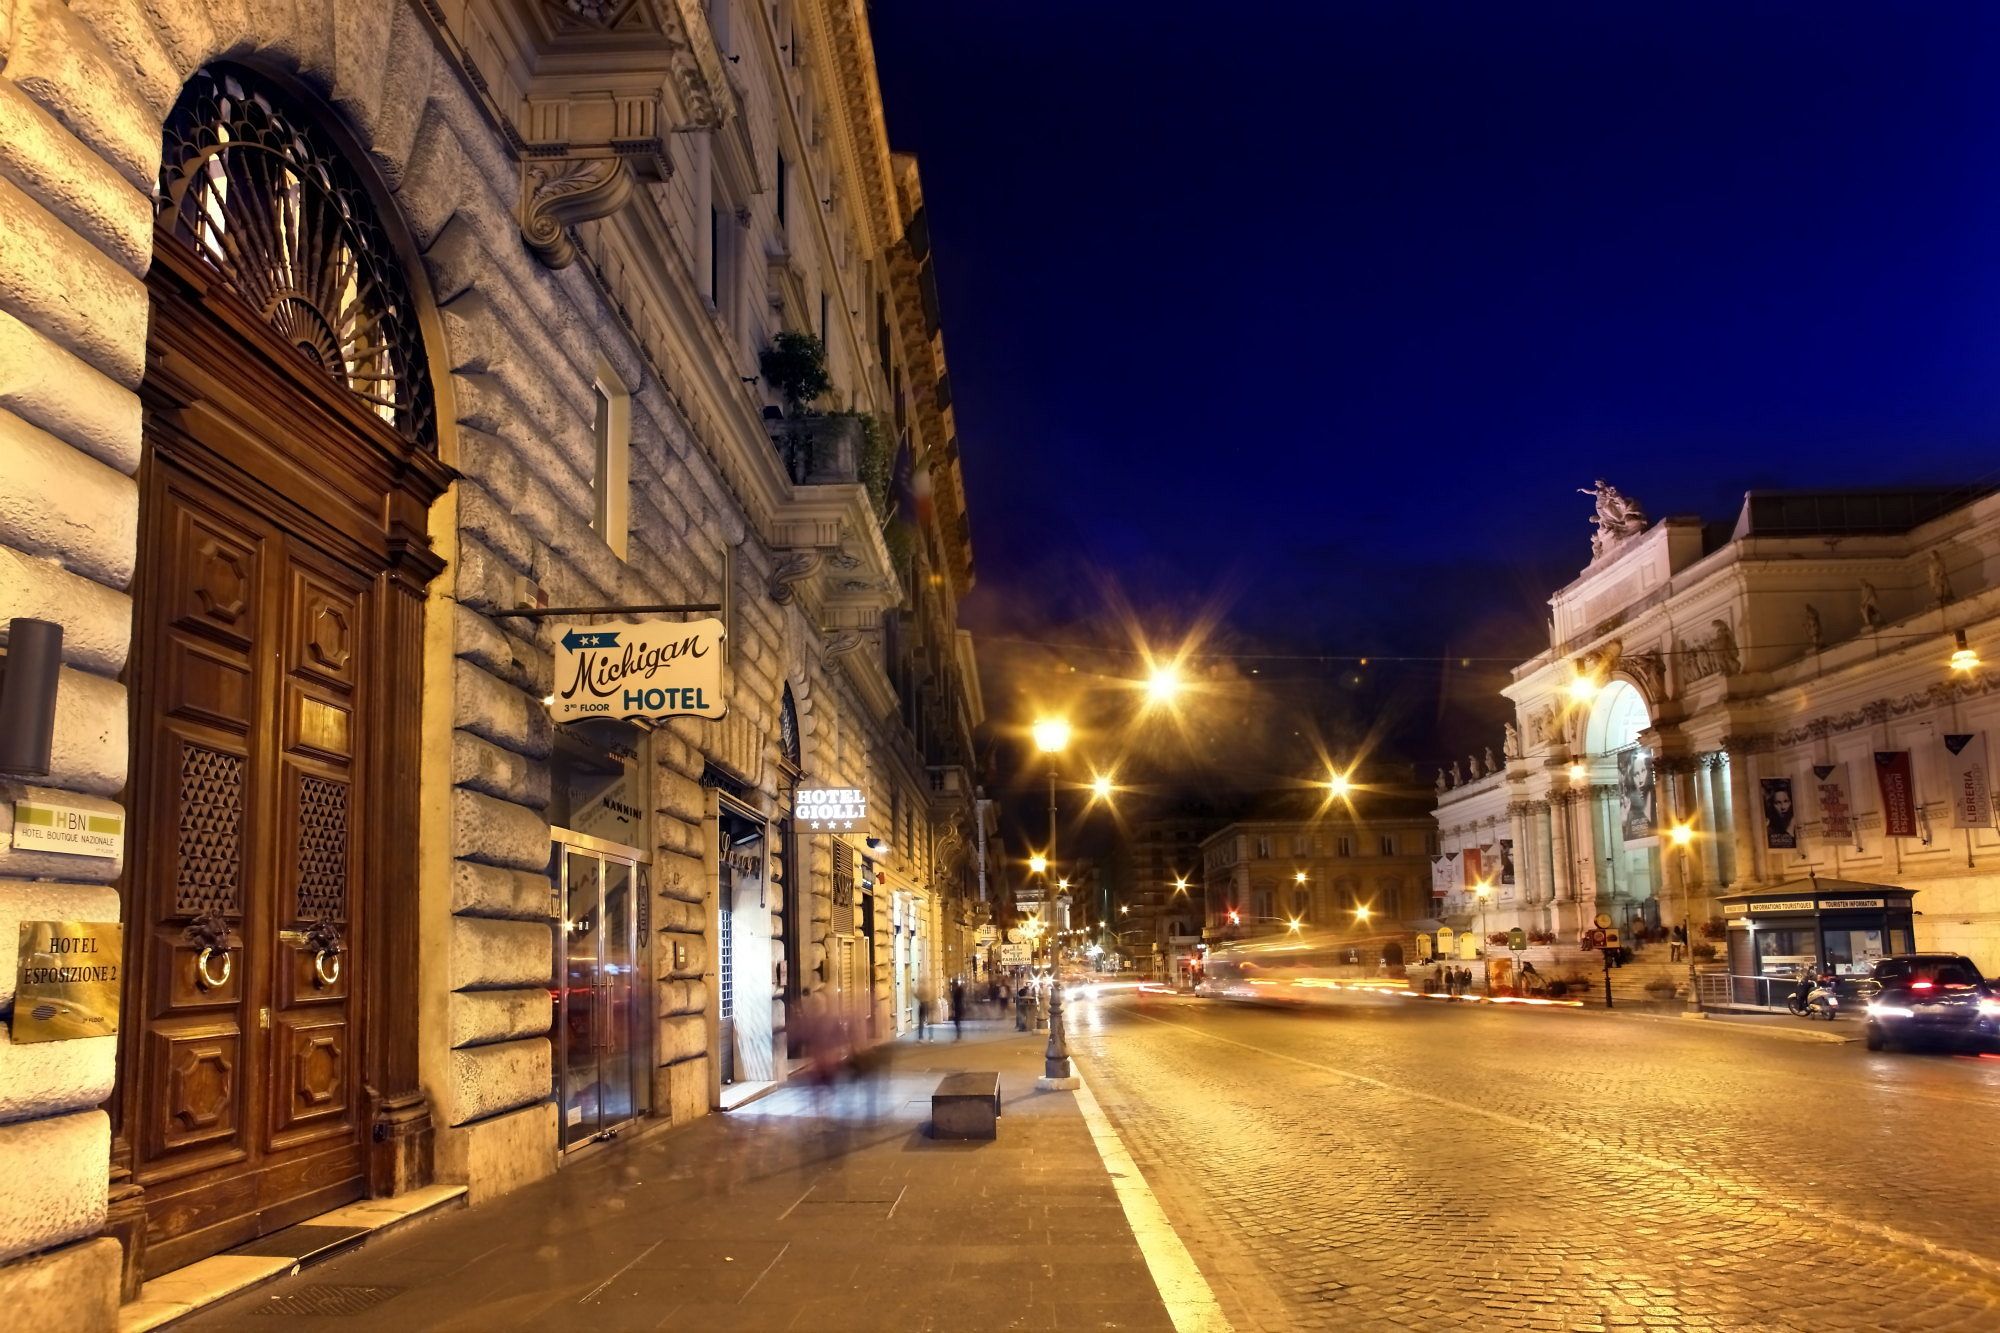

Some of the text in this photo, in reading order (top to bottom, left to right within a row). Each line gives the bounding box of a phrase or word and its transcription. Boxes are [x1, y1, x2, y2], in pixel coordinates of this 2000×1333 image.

[561, 635, 709, 699] Michigan
[580, 703, 610, 712] FLOOR
[623, 687, 710, 711] HOTEL
[797, 789, 866, 805] HOTEL
[1963, 770, 1977, 823] LIBRERIA
[1972, 763, 1986, 823] BOOKSHOP
[602, 797, 642, 820] NANNINI
[795, 804, 867, 819] GIOLLI
[56, 811, 87, 831] HBN
[22, 828, 114, 847] HOTEL BOUTIQUE NAZIONALE
[1752, 903, 1782, 911] INFORMATIONS
[1782, 902, 1811, 910] TOURISTIQUES
[49, 937, 99, 954] HOTEL
[23, 966, 117, 985] ESPOSIZIONE 2
